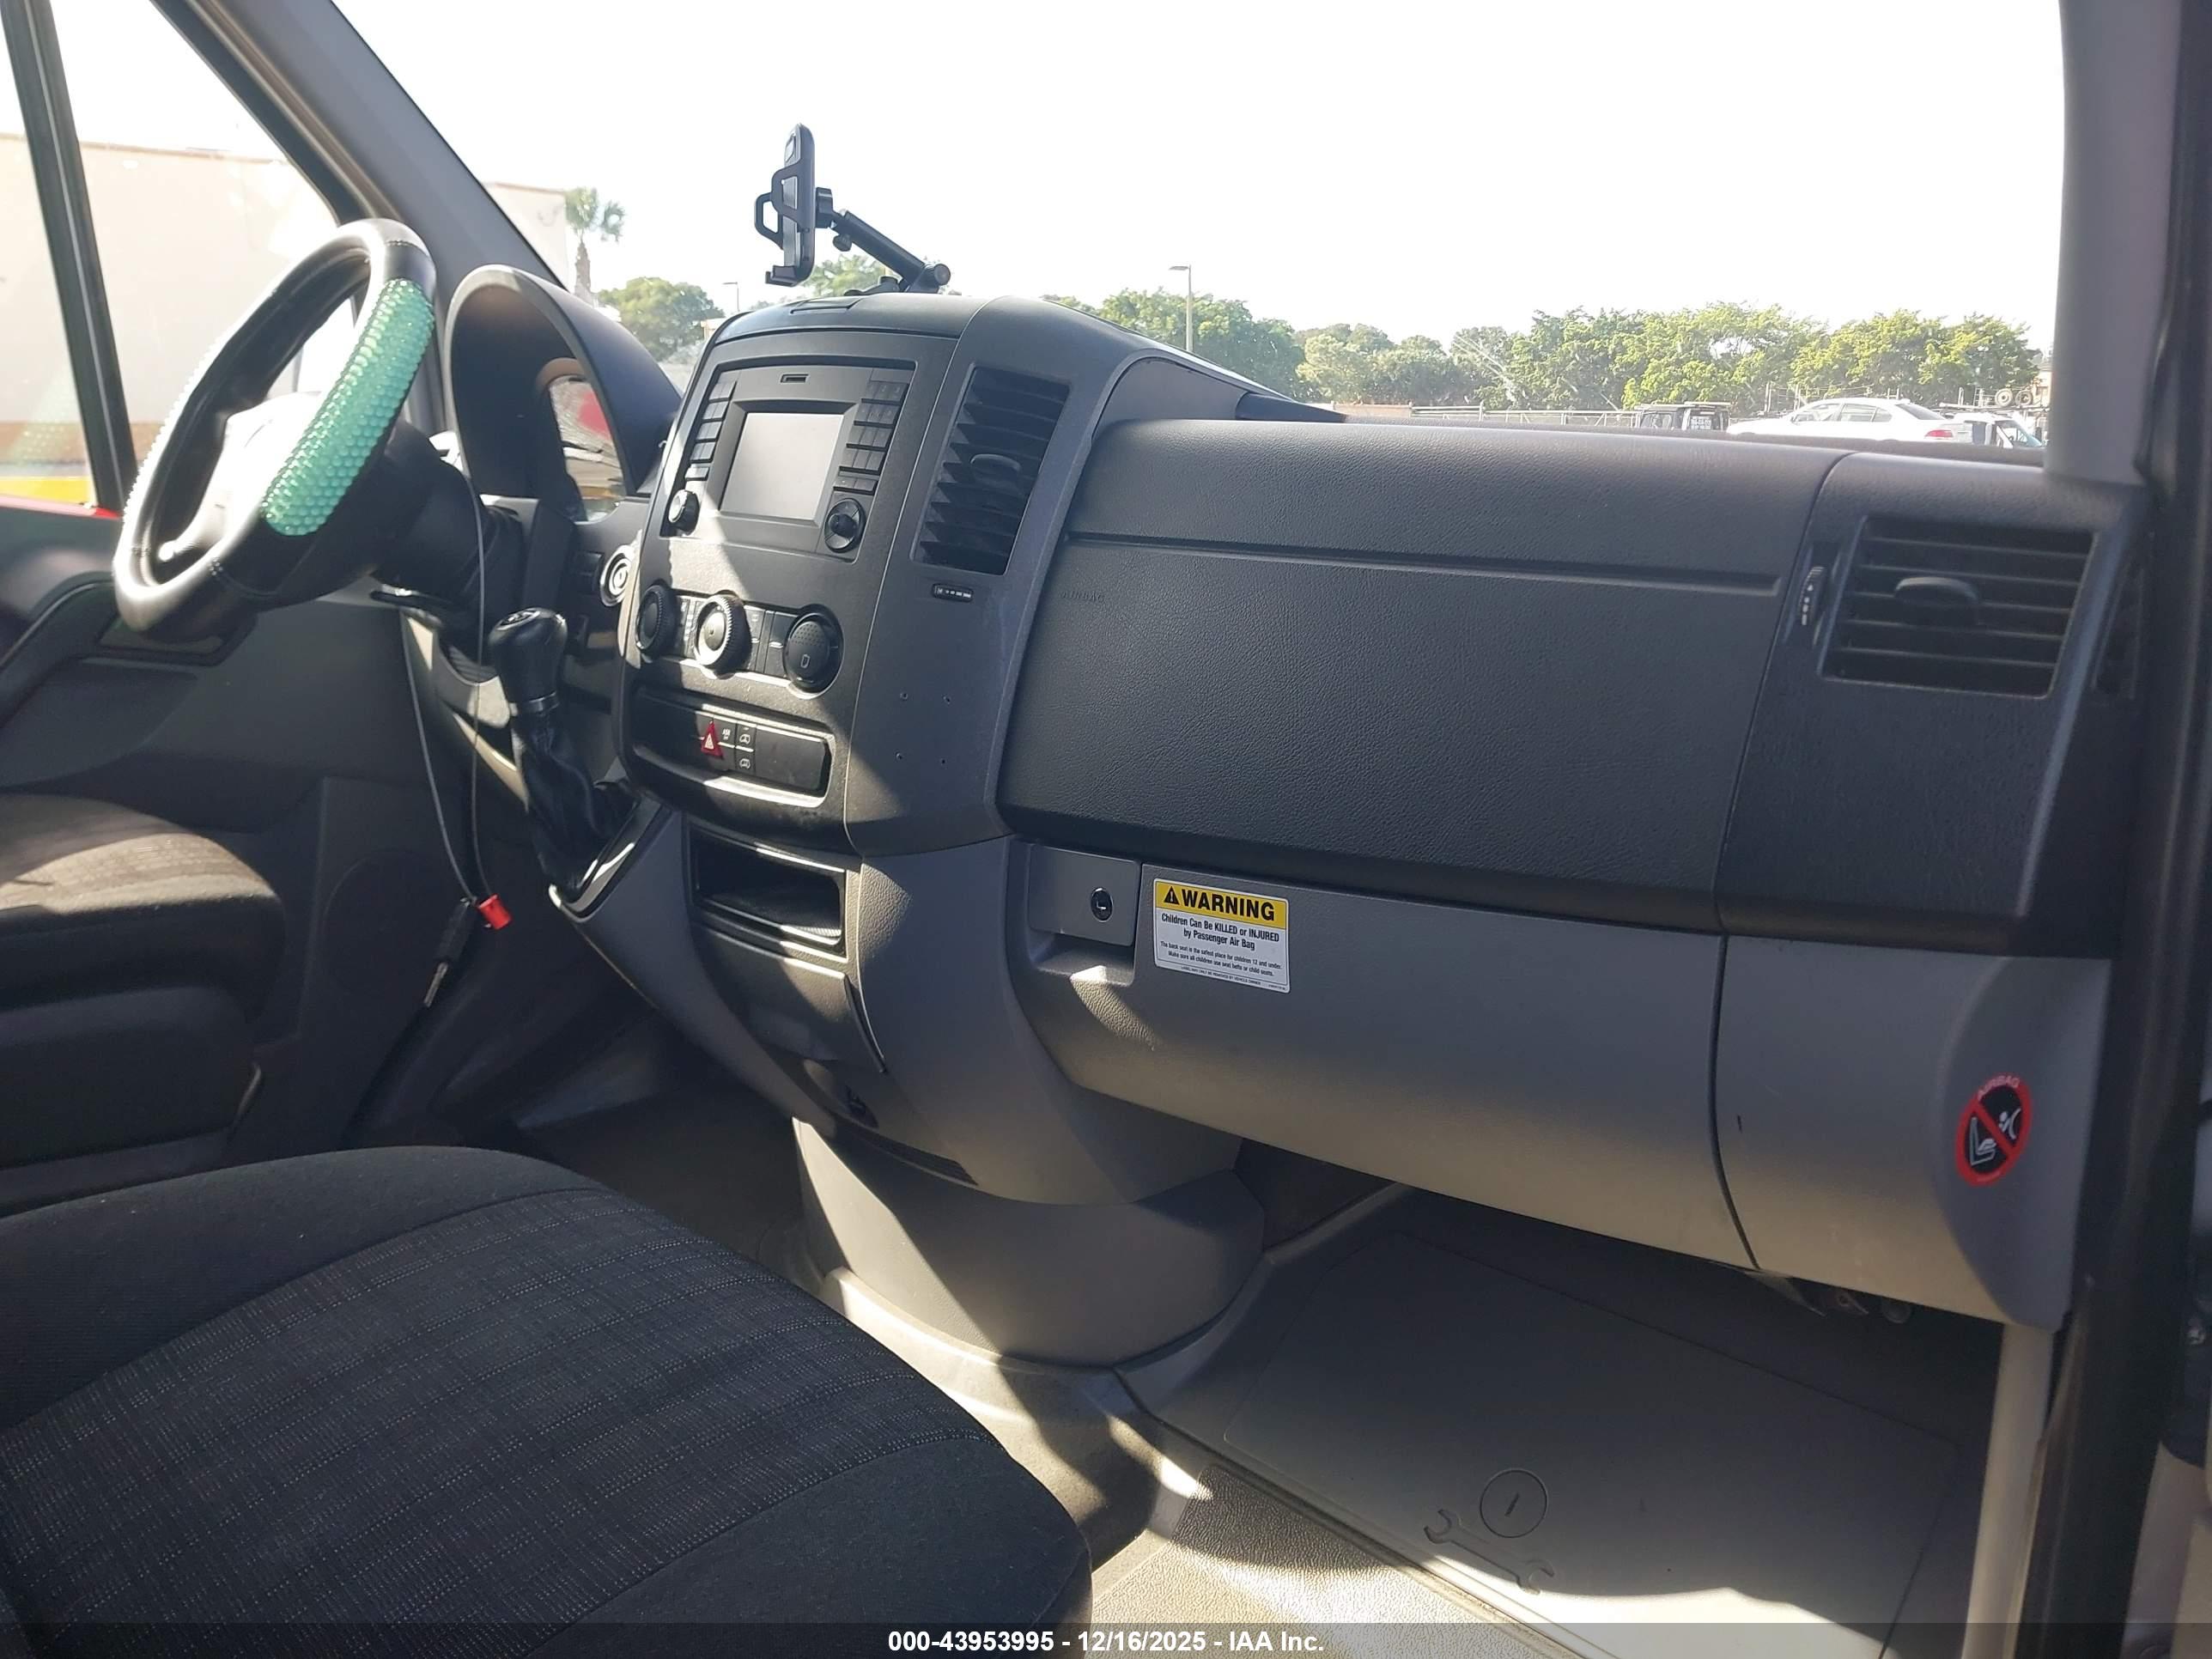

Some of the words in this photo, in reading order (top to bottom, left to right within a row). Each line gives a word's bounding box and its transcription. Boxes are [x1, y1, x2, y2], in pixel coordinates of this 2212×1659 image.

[1182, 889, 1274, 921] WARNING
[1162, 913, 1188, 926] Children
[1189, 918, 1202, 928] Can
[1204, 921, 1213, 930] Be
[1214, 922, 1237, 934] KILLED
[1239, 928, 1248, 937] or
[1249, 928, 1279, 942] INJURED
[1183, 927, 1192, 939] by
[1194, 930, 1228, 945] Passenger
[1230, 936, 1240, 946] Air
[1242, 939, 1255, 951] Bag
[1234, 955, 1251, 963] children
